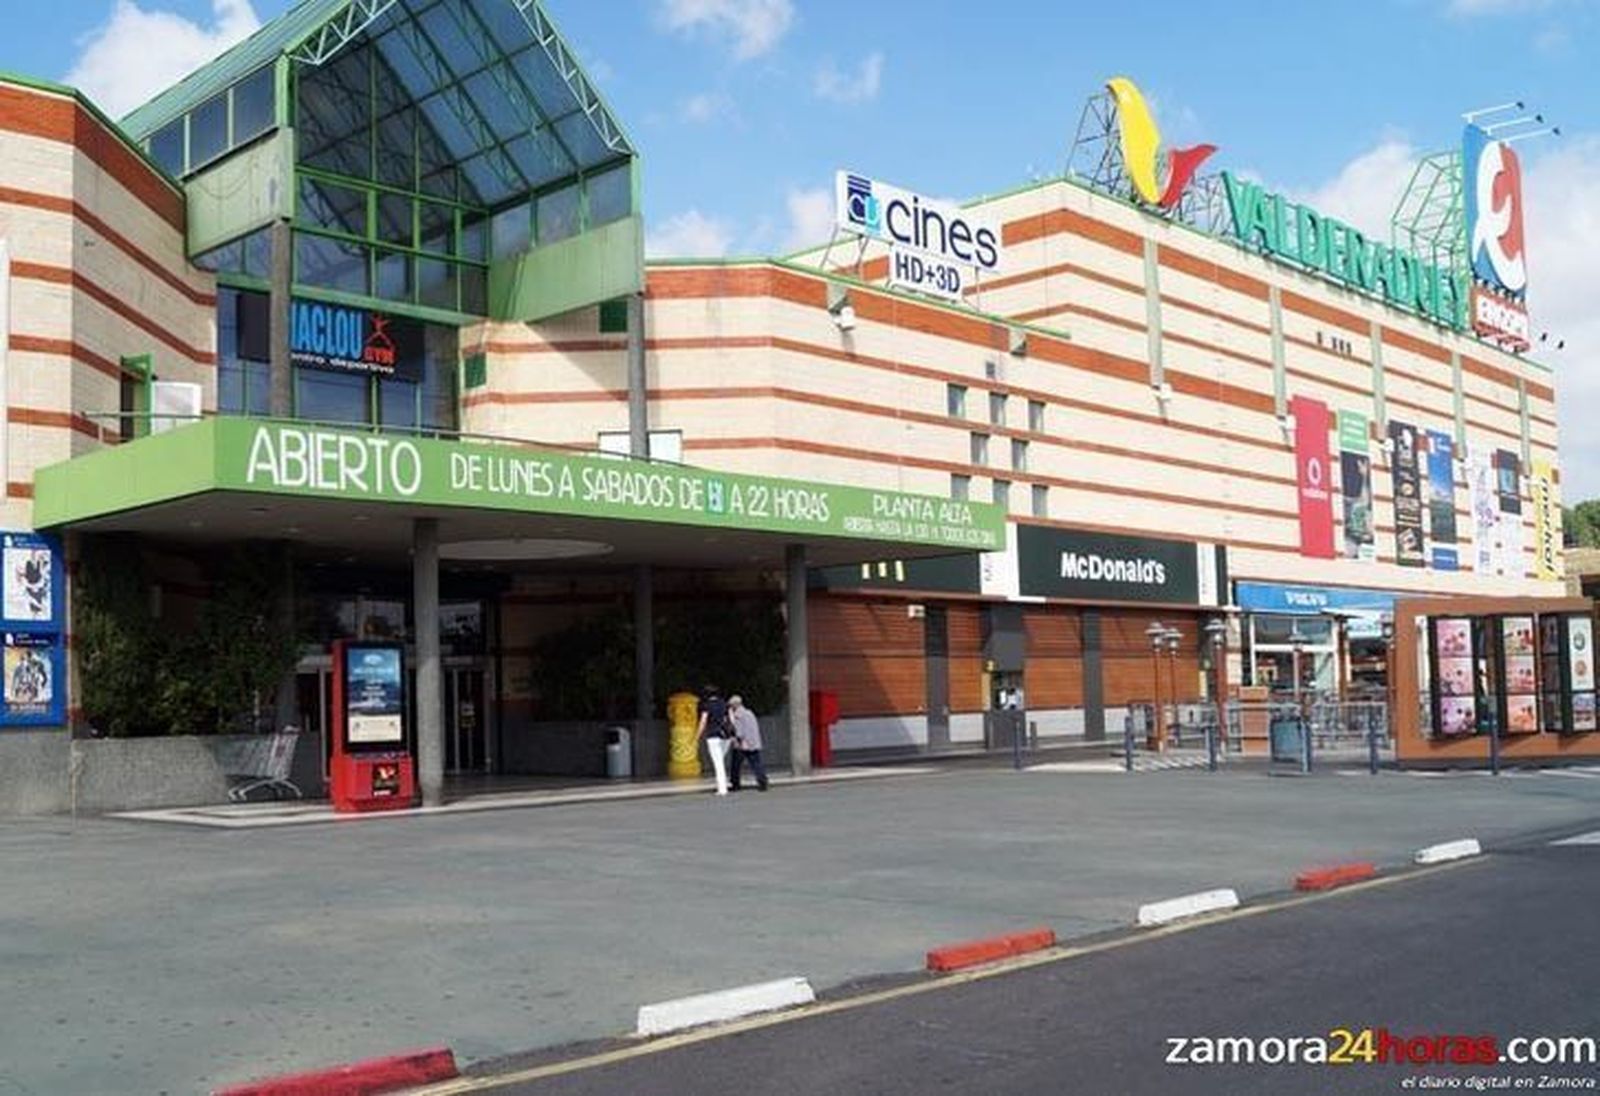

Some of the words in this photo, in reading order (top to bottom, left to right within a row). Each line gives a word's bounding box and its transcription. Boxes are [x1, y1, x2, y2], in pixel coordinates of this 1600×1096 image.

[886, 195, 998, 268] cines
[895, 252, 960, 293] HD+3D
[290, 302, 362, 359] ACLOU
[246, 426, 422, 496] ABIERTO
[451, 453, 482, 490] DE
[488, 456, 553, 497] LUNES
[558, 465, 576, 500] A
[582, 467, 674, 508] SABADOS
[680, 477, 704, 511] DE
[729, 482, 744, 514] A
[748, 485, 769, 516] 22
[774, 486, 831, 522] HORAS
[873, 493, 934, 521] PLANTA
[939, 502, 973, 525] ALTA
[1061, 552, 1166, 585] McDonald's
